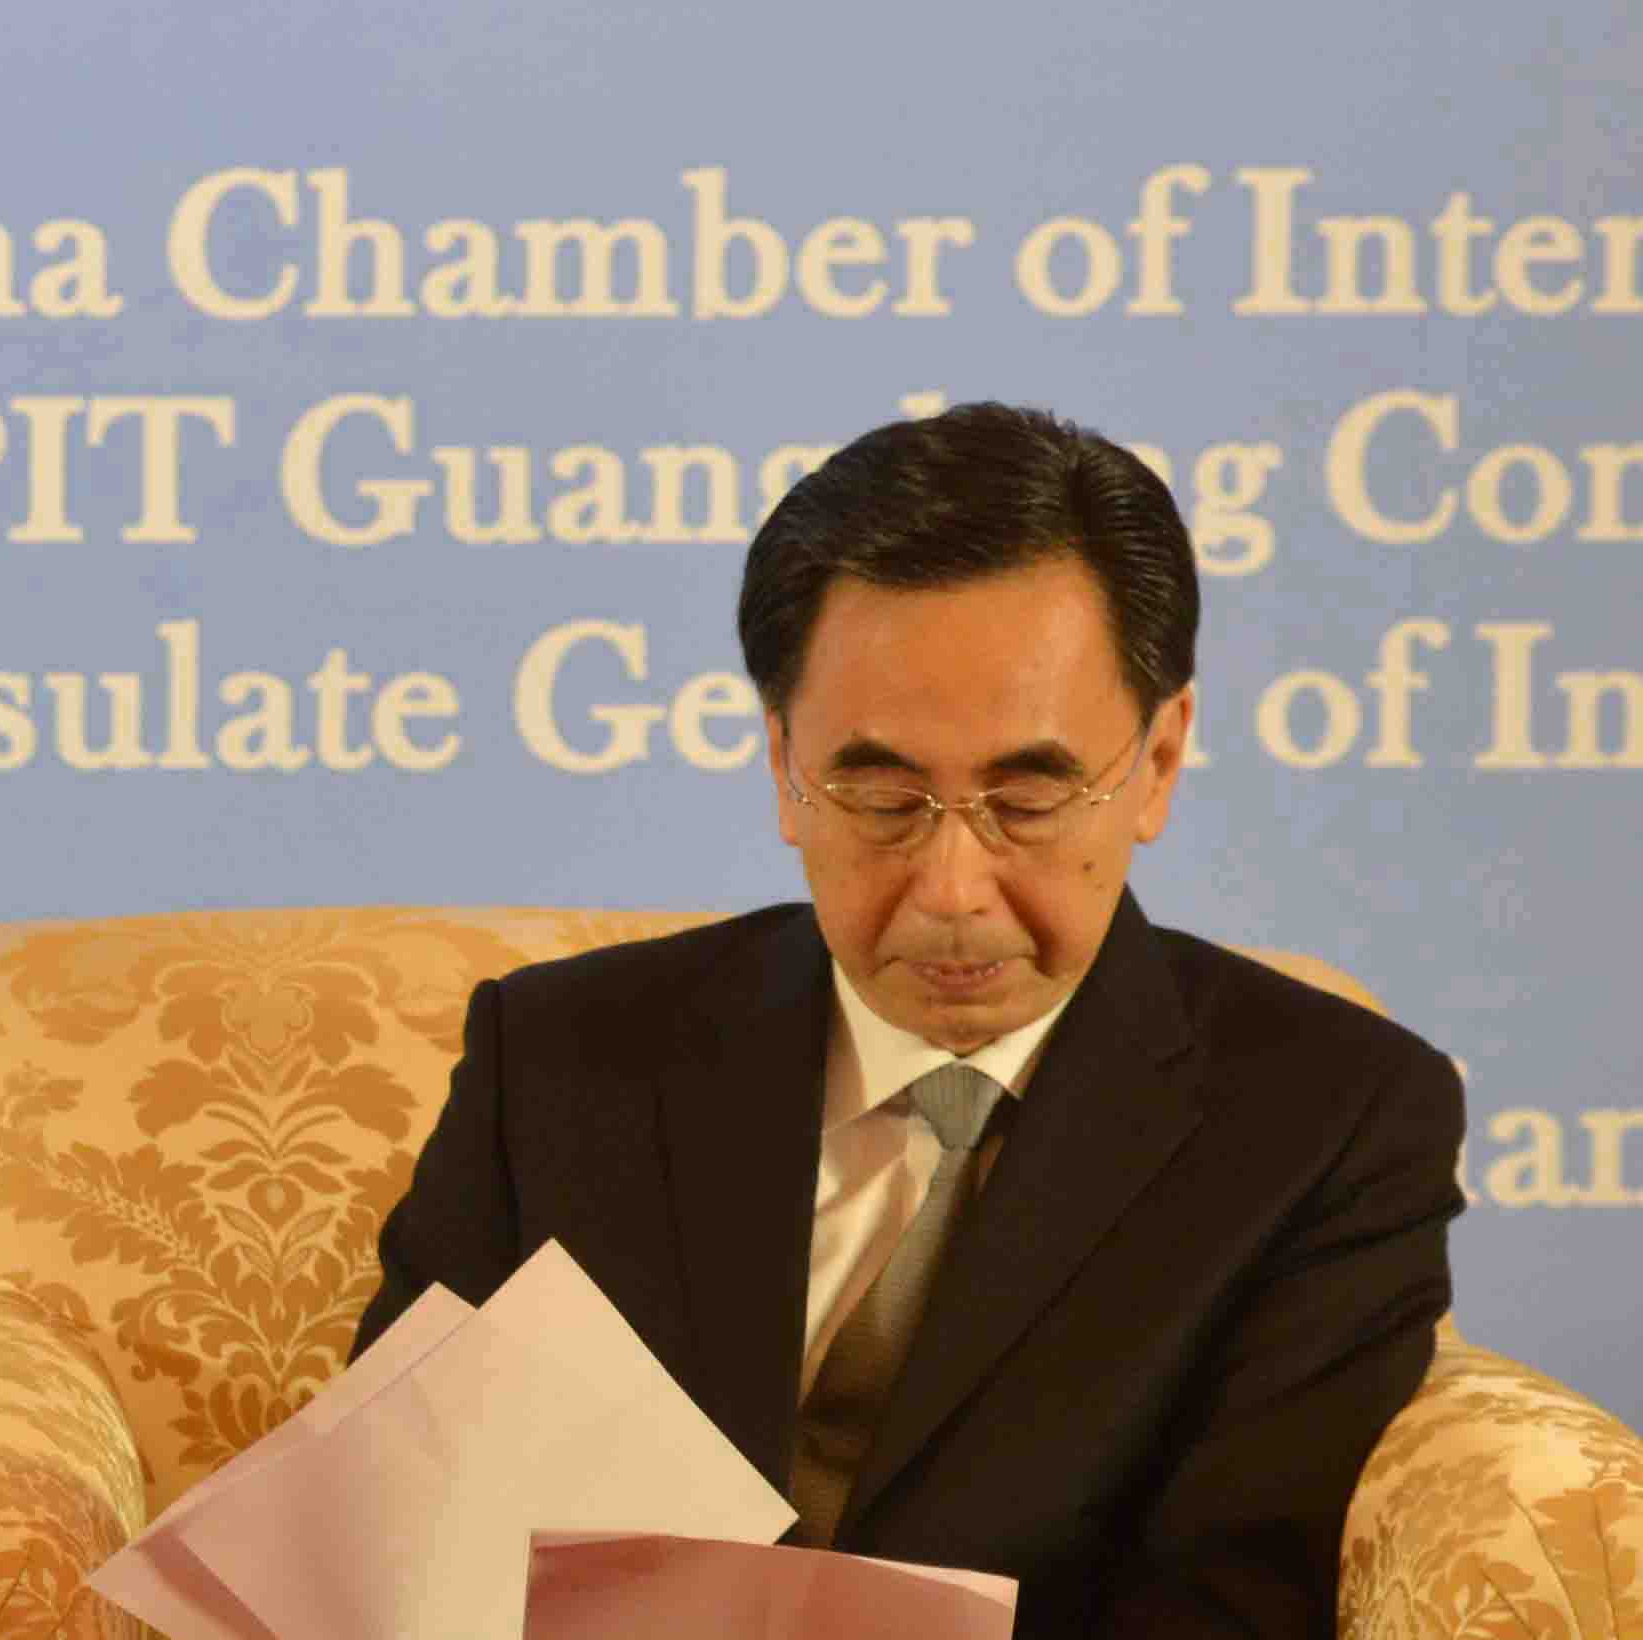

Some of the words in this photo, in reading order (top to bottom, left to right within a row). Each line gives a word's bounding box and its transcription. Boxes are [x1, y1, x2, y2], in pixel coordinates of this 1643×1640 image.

[168, 165, 973, 320] Chamber
[1016, 163, 1210, 319] of
[1255, 618, 1450, 770] of
